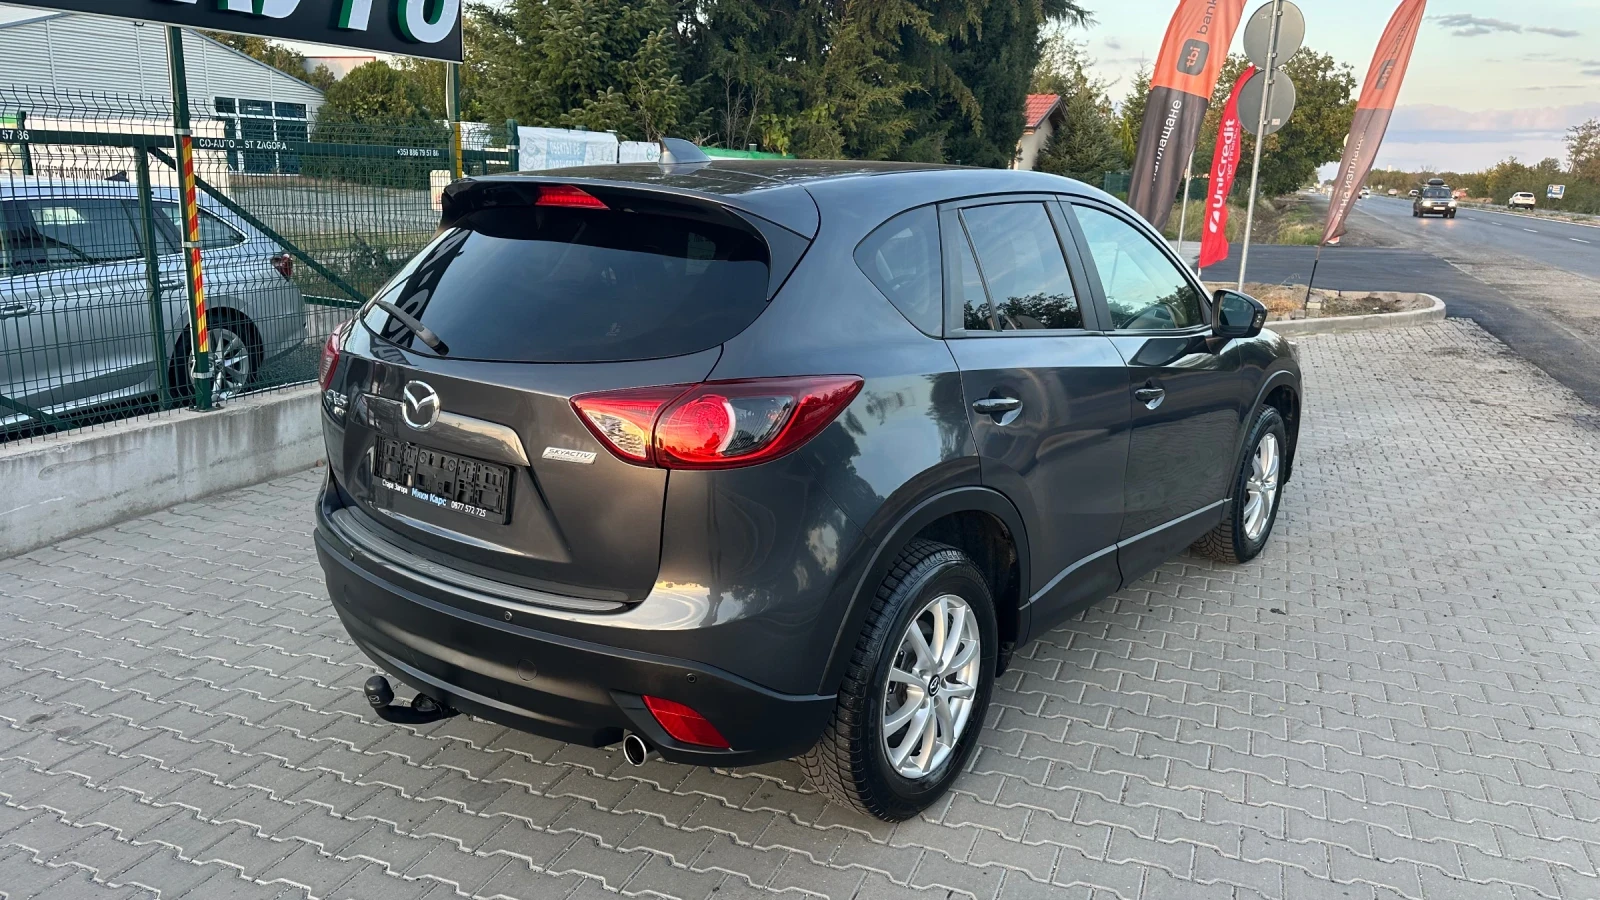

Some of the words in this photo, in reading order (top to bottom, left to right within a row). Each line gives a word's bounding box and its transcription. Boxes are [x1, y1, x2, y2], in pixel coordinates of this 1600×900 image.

[1185, 46, 1201, 68] tbi
[1213, 118, 1235, 208] UniCredit
[547, 448, 592, 458] SKYACTIV
[429, 493, 447, 506] Карс
[464, 504, 475, 515] 572
[475, 507, 487, 518] 725
